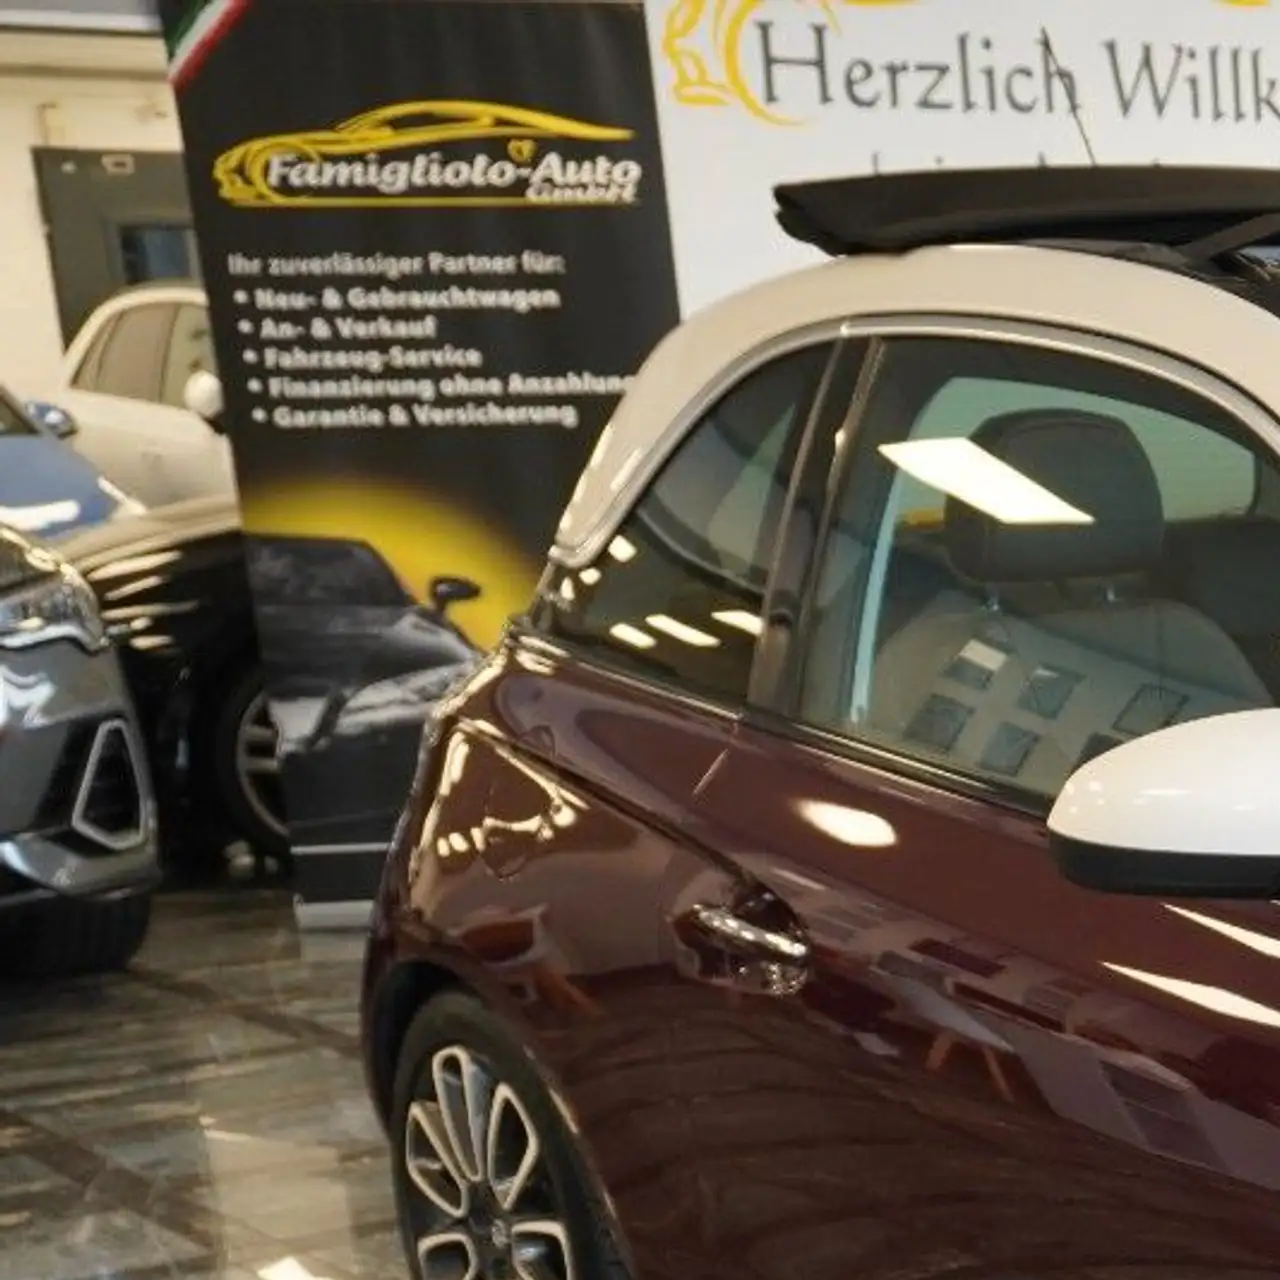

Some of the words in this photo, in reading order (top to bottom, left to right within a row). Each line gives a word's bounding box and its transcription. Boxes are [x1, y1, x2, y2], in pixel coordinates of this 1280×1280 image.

[754, 20, 1081, 114] Herzlich
[227, 252, 262, 275] Ihr
[267, 252, 425, 281] zuverlässiger
[428, 252, 518, 275] Partner
[254, 288, 317, 311] Neu-
[321, 286, 344, 311] &
[347, 285, 562, 314] Gebrauchtwagen
[260, 317, 306, 340] An-
[310, 316, 333, 340] &
[334, 314, 439, 340] Verkauf
[263, 343, 483, 374] Fahrzeug-Service
[267, 374, 437, 402] Finanzierung
[438, 372, 503, 397] ohne
[272, 404, 387, 430] Garantie
[389, 403, 410, 428] &
[411, 401, 579, 430] Versicherung
